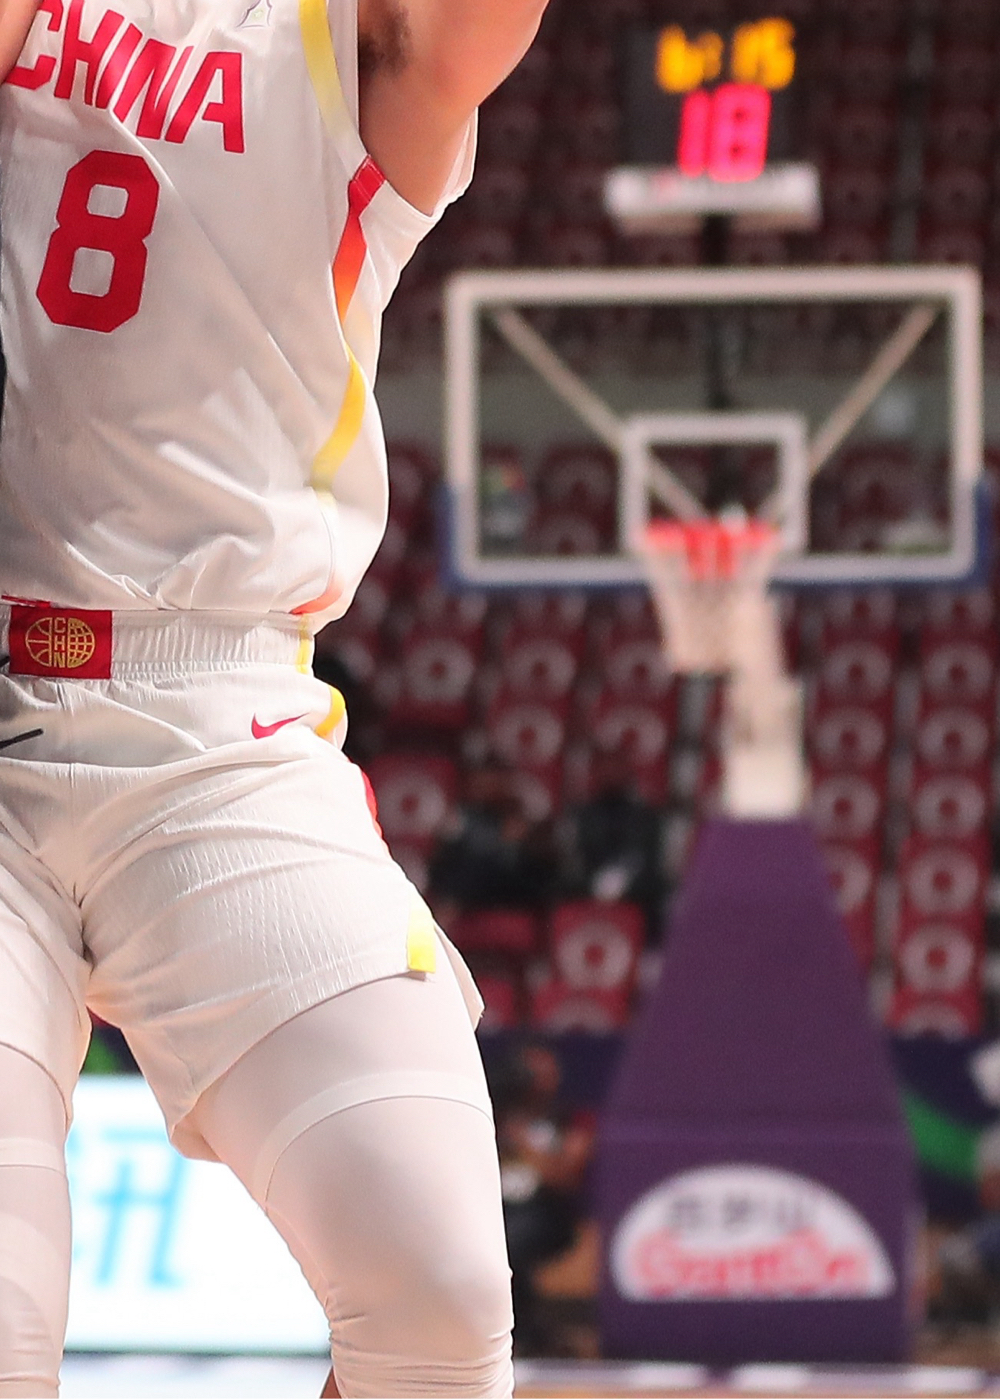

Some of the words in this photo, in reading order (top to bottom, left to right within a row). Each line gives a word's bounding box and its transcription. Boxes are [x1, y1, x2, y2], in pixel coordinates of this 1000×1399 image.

[679, 83, 771, 182] 18
[36, 149, 160, 334] 8
[53, 616, 67, 669] CHN
